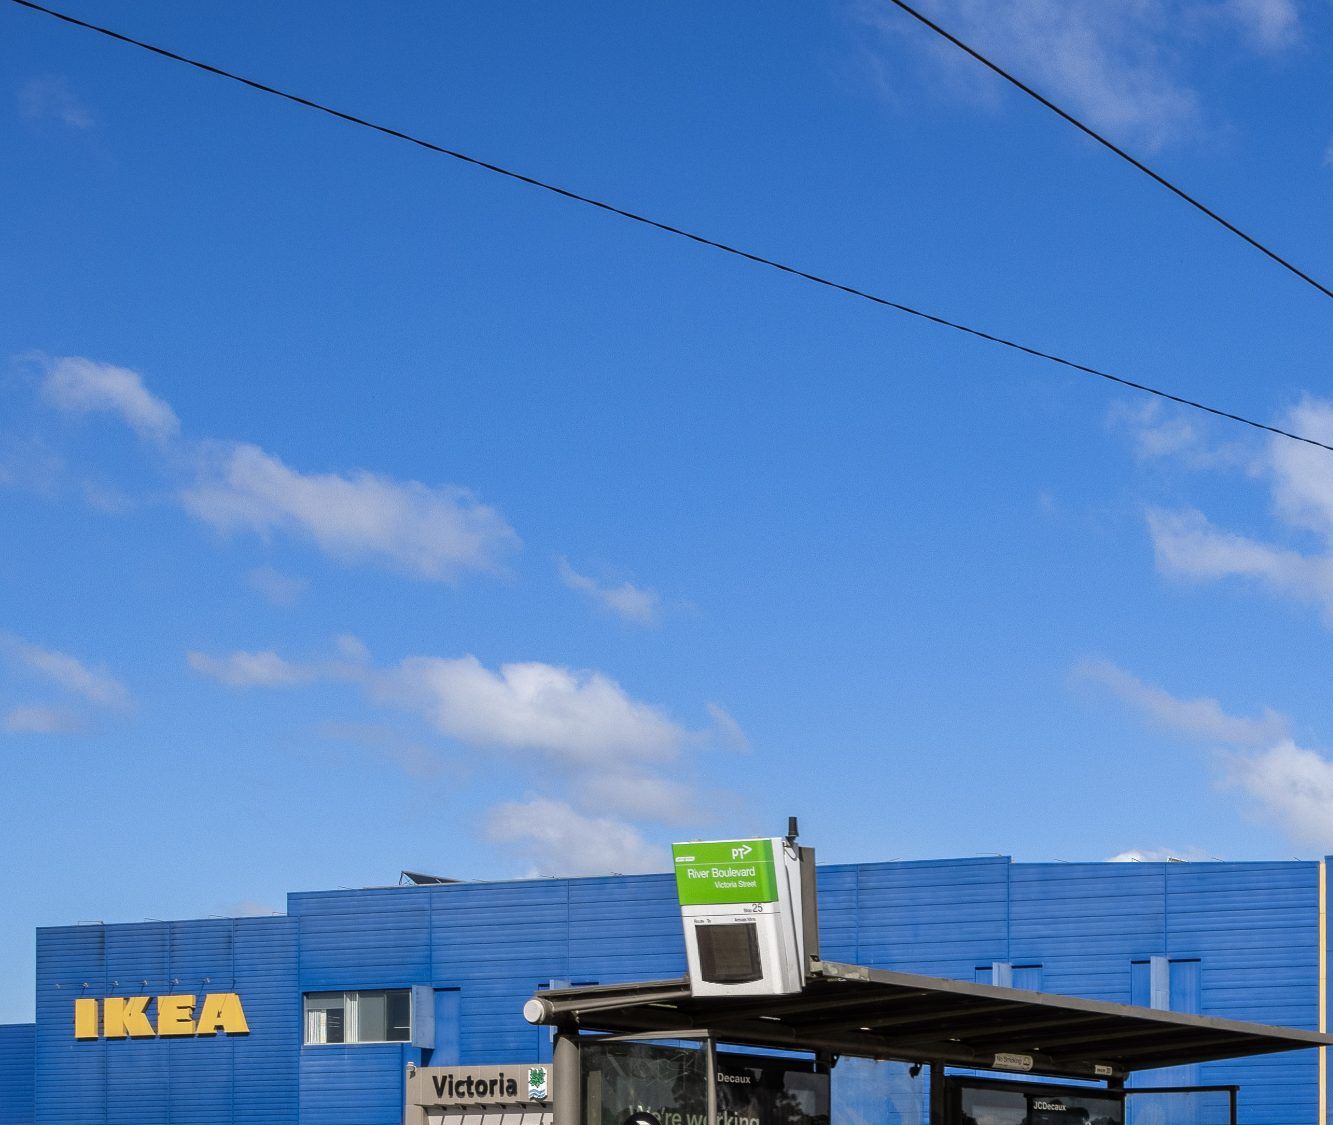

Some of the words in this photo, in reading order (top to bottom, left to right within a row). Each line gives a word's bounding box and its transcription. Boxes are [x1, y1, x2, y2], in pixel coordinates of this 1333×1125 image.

[687, 868, 709, 879] River
[711, 866, 755, 878] Boulevard
[714, 881, 737, 889] Victoria
[738, 880, 757, 888] Street
[752, 903, 763, 912] 25
[74, 992, 250, 1040] IKEA
[432, 1072, 518, 1098] Victoria
[1033, 1101, 1067, 1112] JCDecaux
